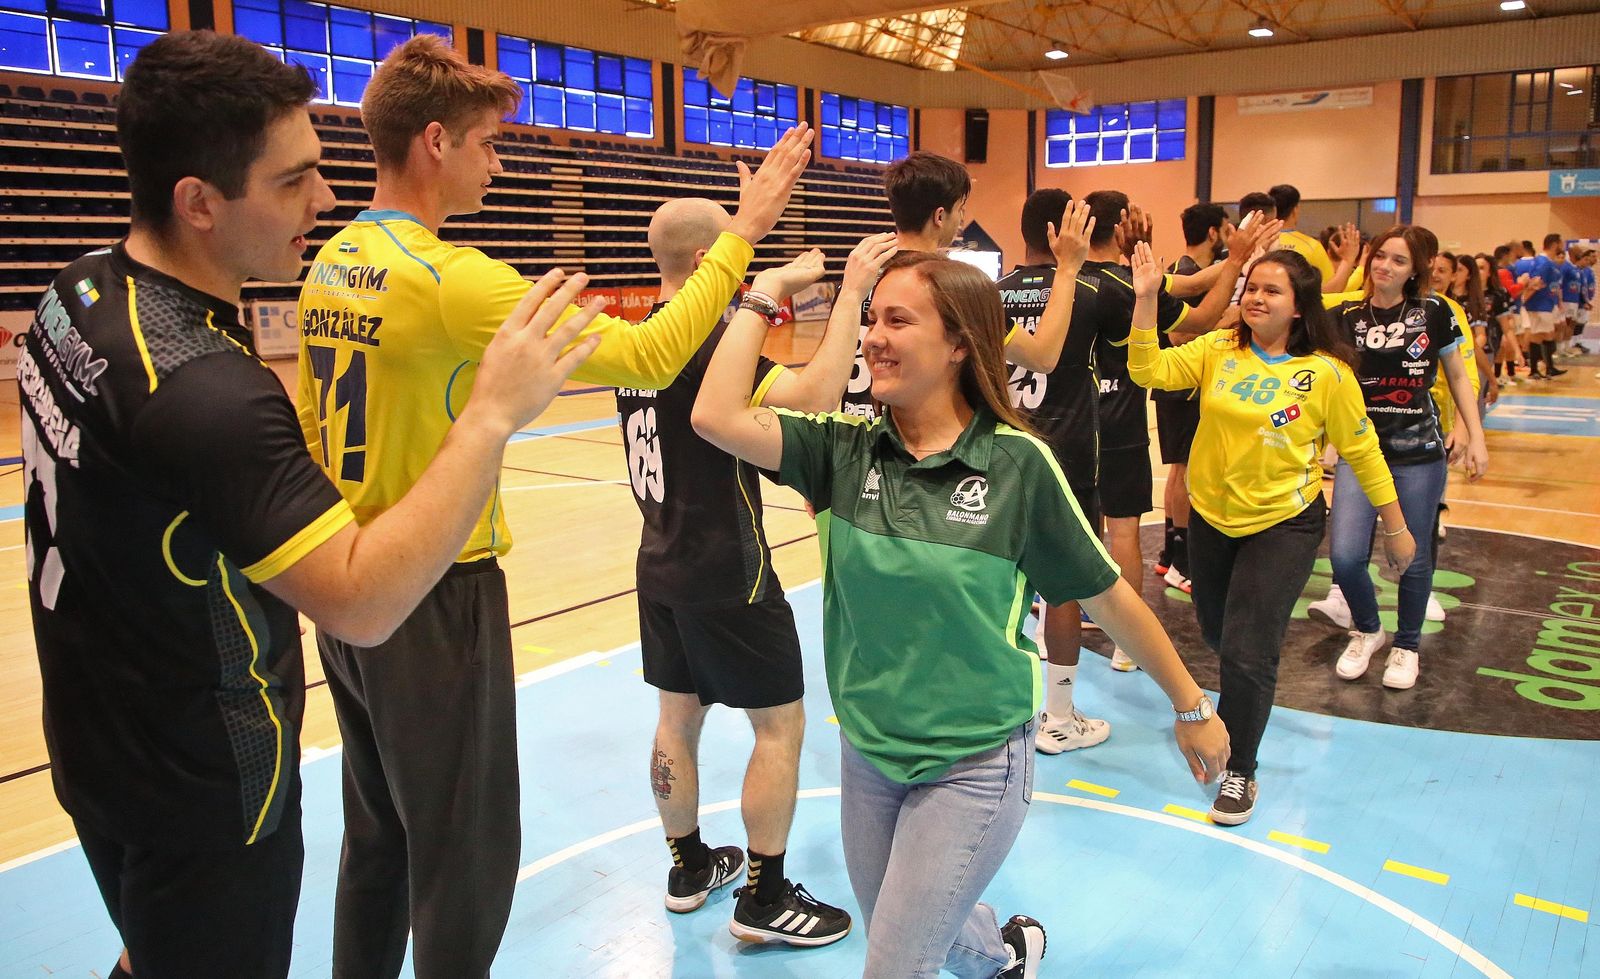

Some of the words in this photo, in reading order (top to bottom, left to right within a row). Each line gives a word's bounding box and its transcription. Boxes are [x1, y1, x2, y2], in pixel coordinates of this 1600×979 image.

[302, 307, 383, 347] GONZÁLEZ
[1366, 321, 1406, 349] 62
[1230, 373, 1282, 405] 48
[307, 344, 368, 484] 71
